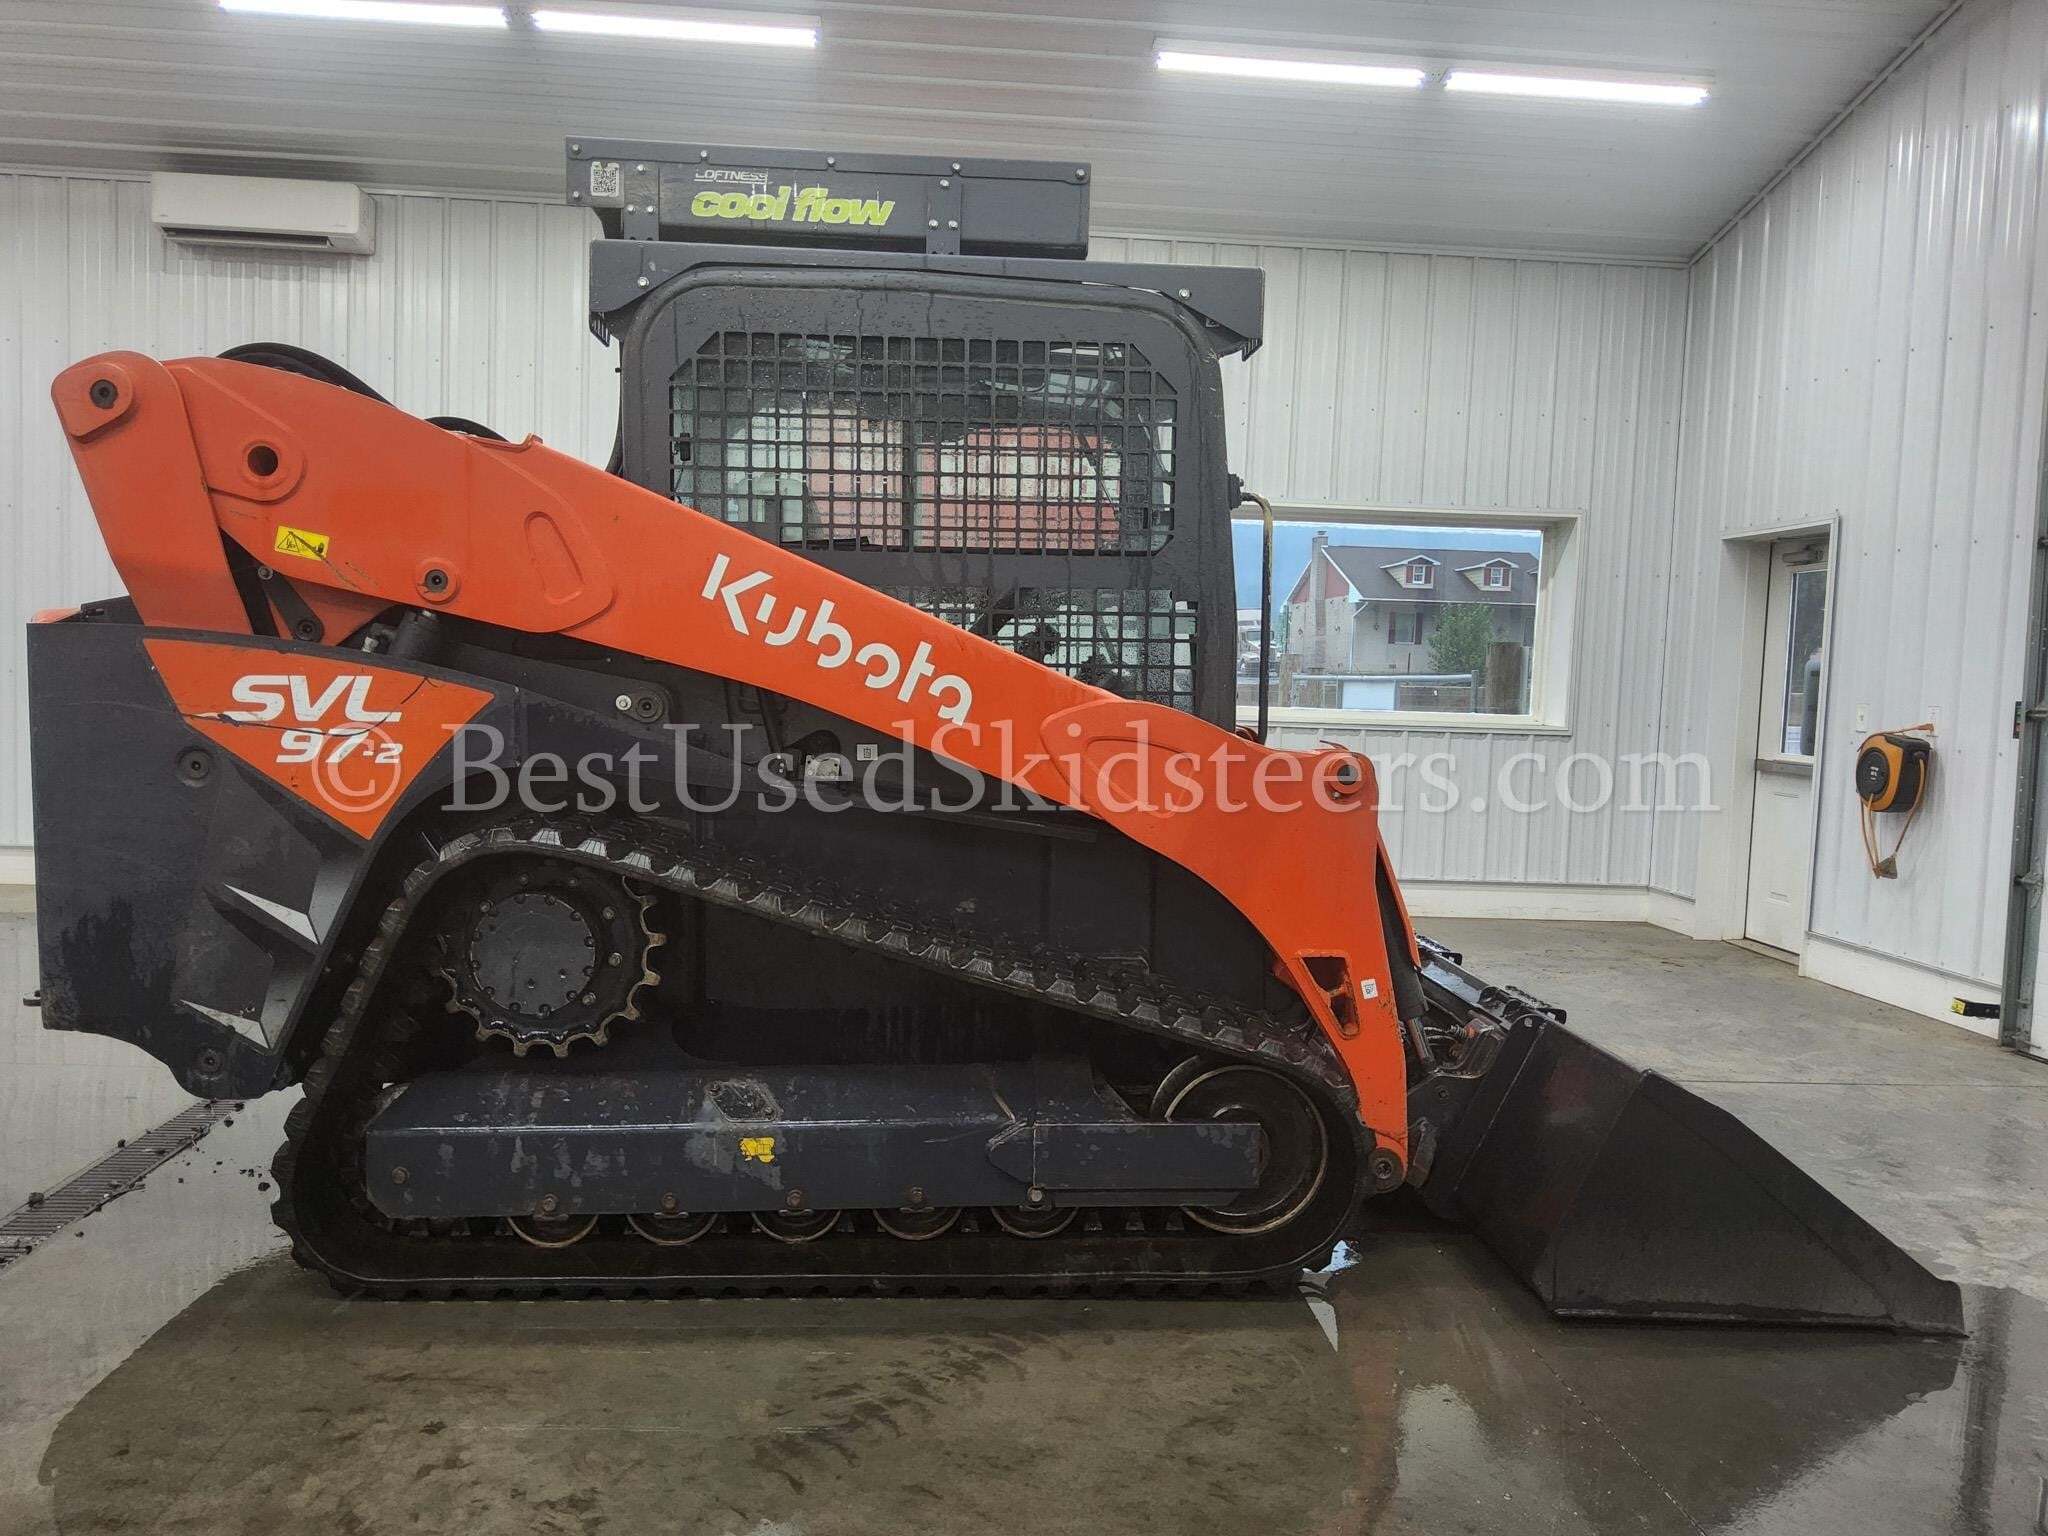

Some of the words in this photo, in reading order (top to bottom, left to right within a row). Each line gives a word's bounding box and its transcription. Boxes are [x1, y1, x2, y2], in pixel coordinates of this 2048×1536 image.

[694, 168, 769, 183] LOFTNESS
[691, 186, 792, 220] cool
[792, 187, 896, 226] flow
[702, 553, 973, 726] Kubota
[223, 675, 403, 722] SVL
